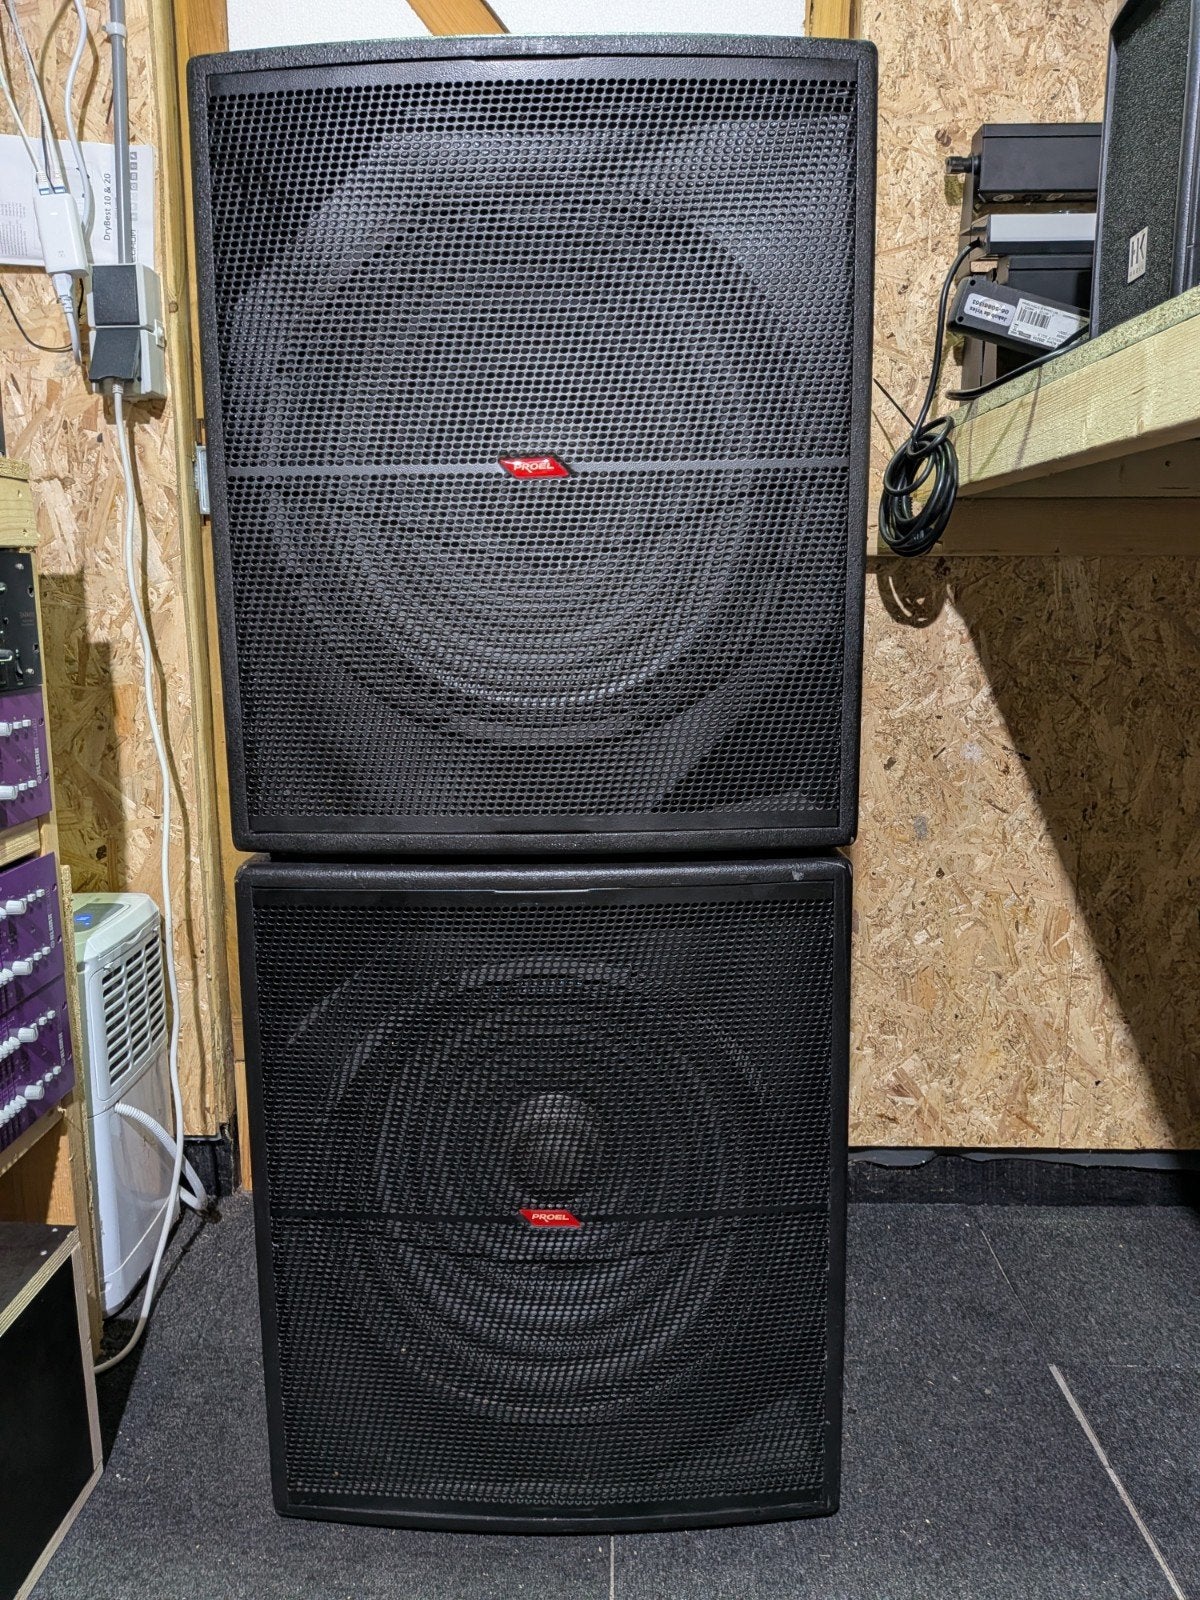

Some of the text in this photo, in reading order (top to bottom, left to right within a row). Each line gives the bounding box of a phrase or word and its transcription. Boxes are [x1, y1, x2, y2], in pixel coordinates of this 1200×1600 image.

[104, 173, 111, 184] 20
[104, 195, 111, 205] 10
[104, 208, 112, 241] DryBest
[513, 462, 554, 473] PROEL
[532, 1214, 569, 1222] PROEL
